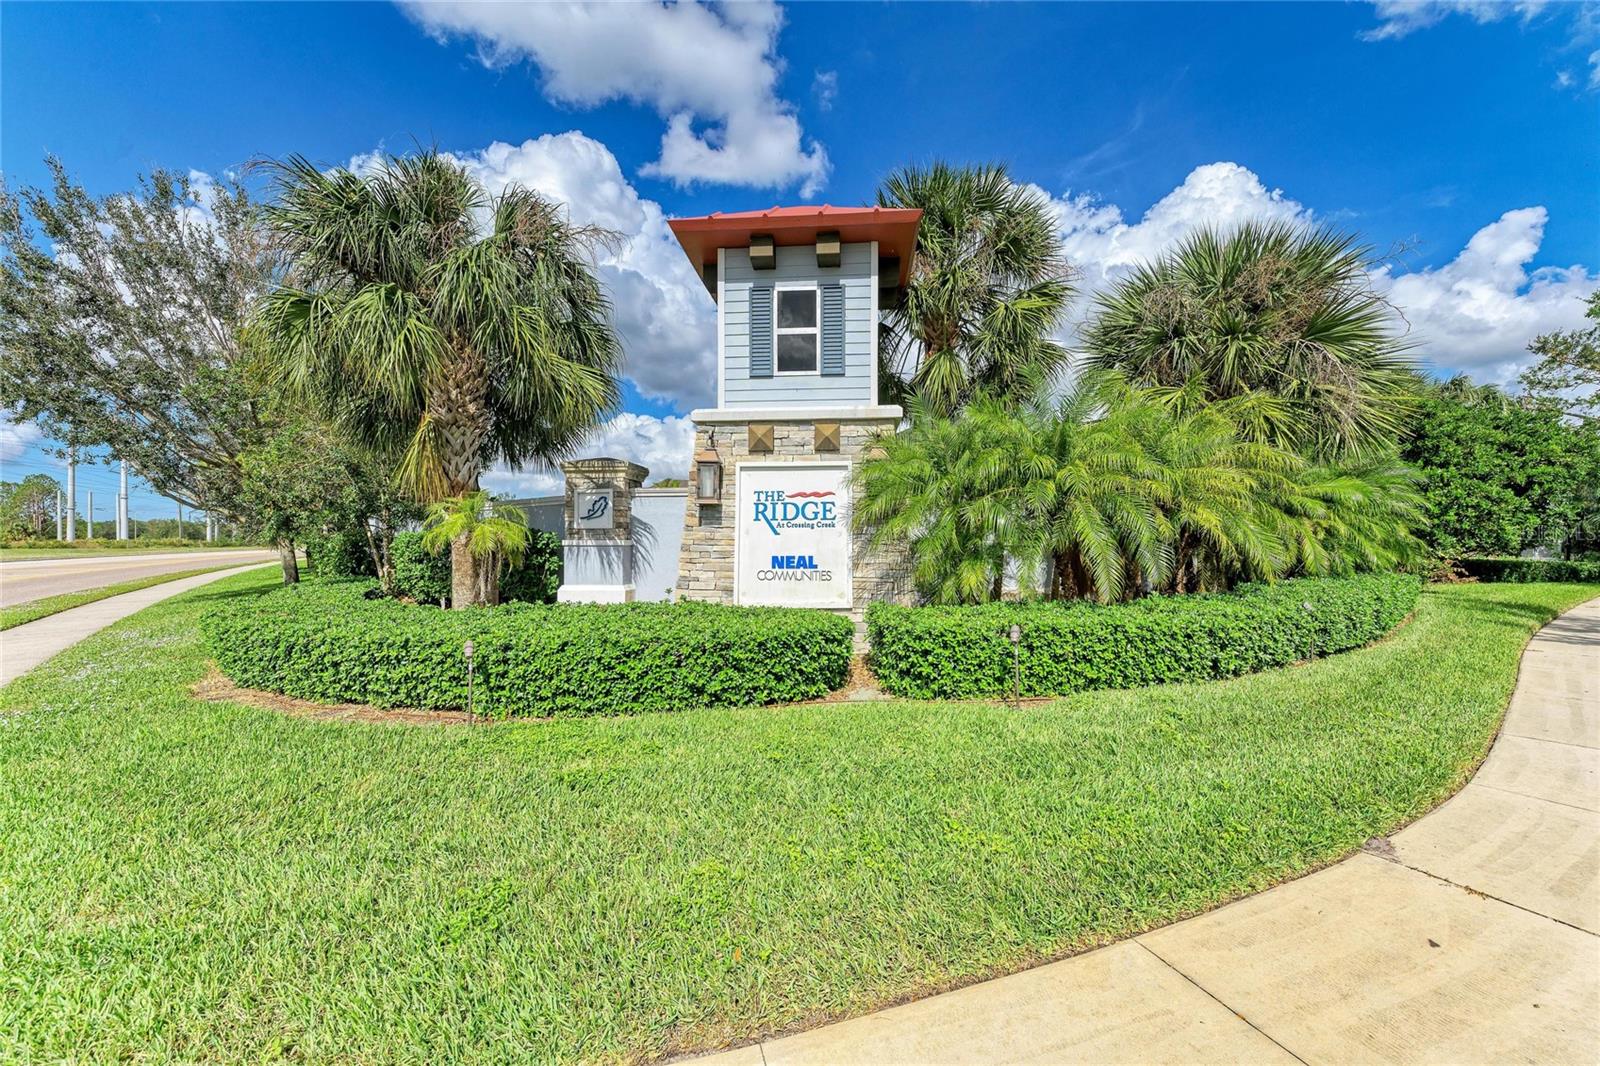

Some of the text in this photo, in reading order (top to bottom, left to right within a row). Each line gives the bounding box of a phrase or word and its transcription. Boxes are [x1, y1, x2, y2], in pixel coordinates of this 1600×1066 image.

[753, 490, 785, 502] THE
[753, 501, 837, 535] RIDGE
[786, 521, 815, 529] Crossing
[771, 555, 818, 569] NEAL
[757, 570, 832, 582] COMMUNITIES
